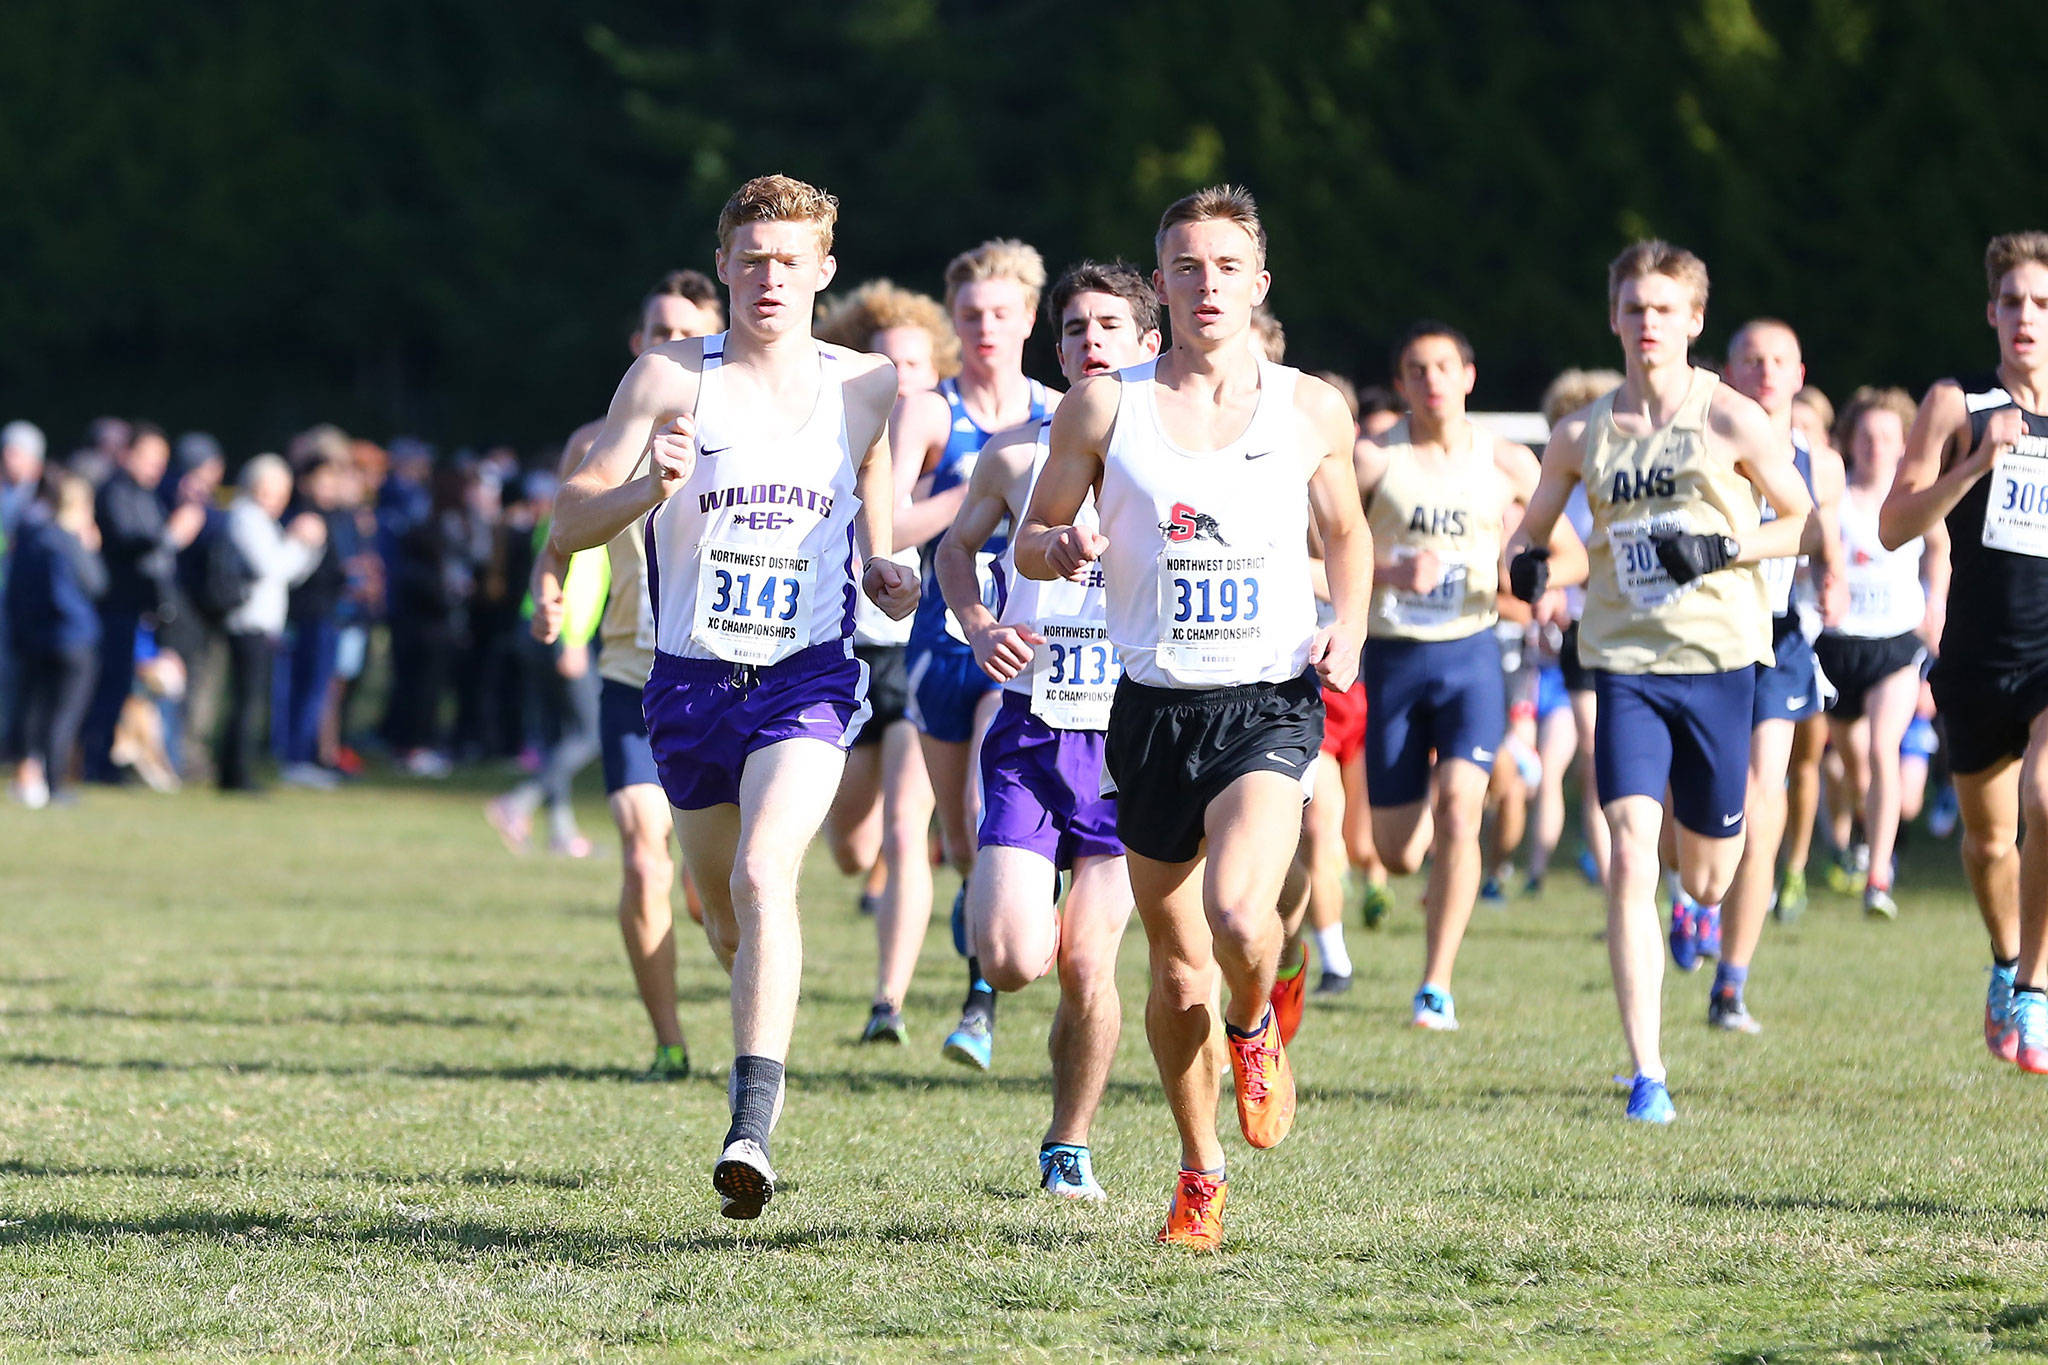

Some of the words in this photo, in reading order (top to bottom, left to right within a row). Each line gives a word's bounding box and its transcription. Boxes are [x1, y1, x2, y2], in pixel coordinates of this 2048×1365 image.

[1612, 467, 1676, 504] AHS
[2002, 478, 2048, 515] 308
[699, 484, 834, 518] WILDCATS
[1170, 502, 1196, 542] S
[1409, 506, 1467, 536] AHS
[710, 549, 766, 568] NORTHWEST
[769, 556, 809, 572] DISTRICT
[1167, 558, 1223, 571] NORTHWEST
[1227, 557, 1265, 571] DISTRICT
[711, 569, 800, 621] 3143
[1174, 577, 1259, 623] 3193
[708, 617, 719, 630] XC
[721, 621, 797, 640] CHAMPIONSHIPS
[1043, 625, 1095, 639] NORTHWEST
[1172, 628, 1184, 640] XC
[1187, 626, 1261, 640] CHAMPIONSHIPS
[1046, 689, 1057, 701] XC
[1058, 690, 1113, 702] CHAMPIONSH
